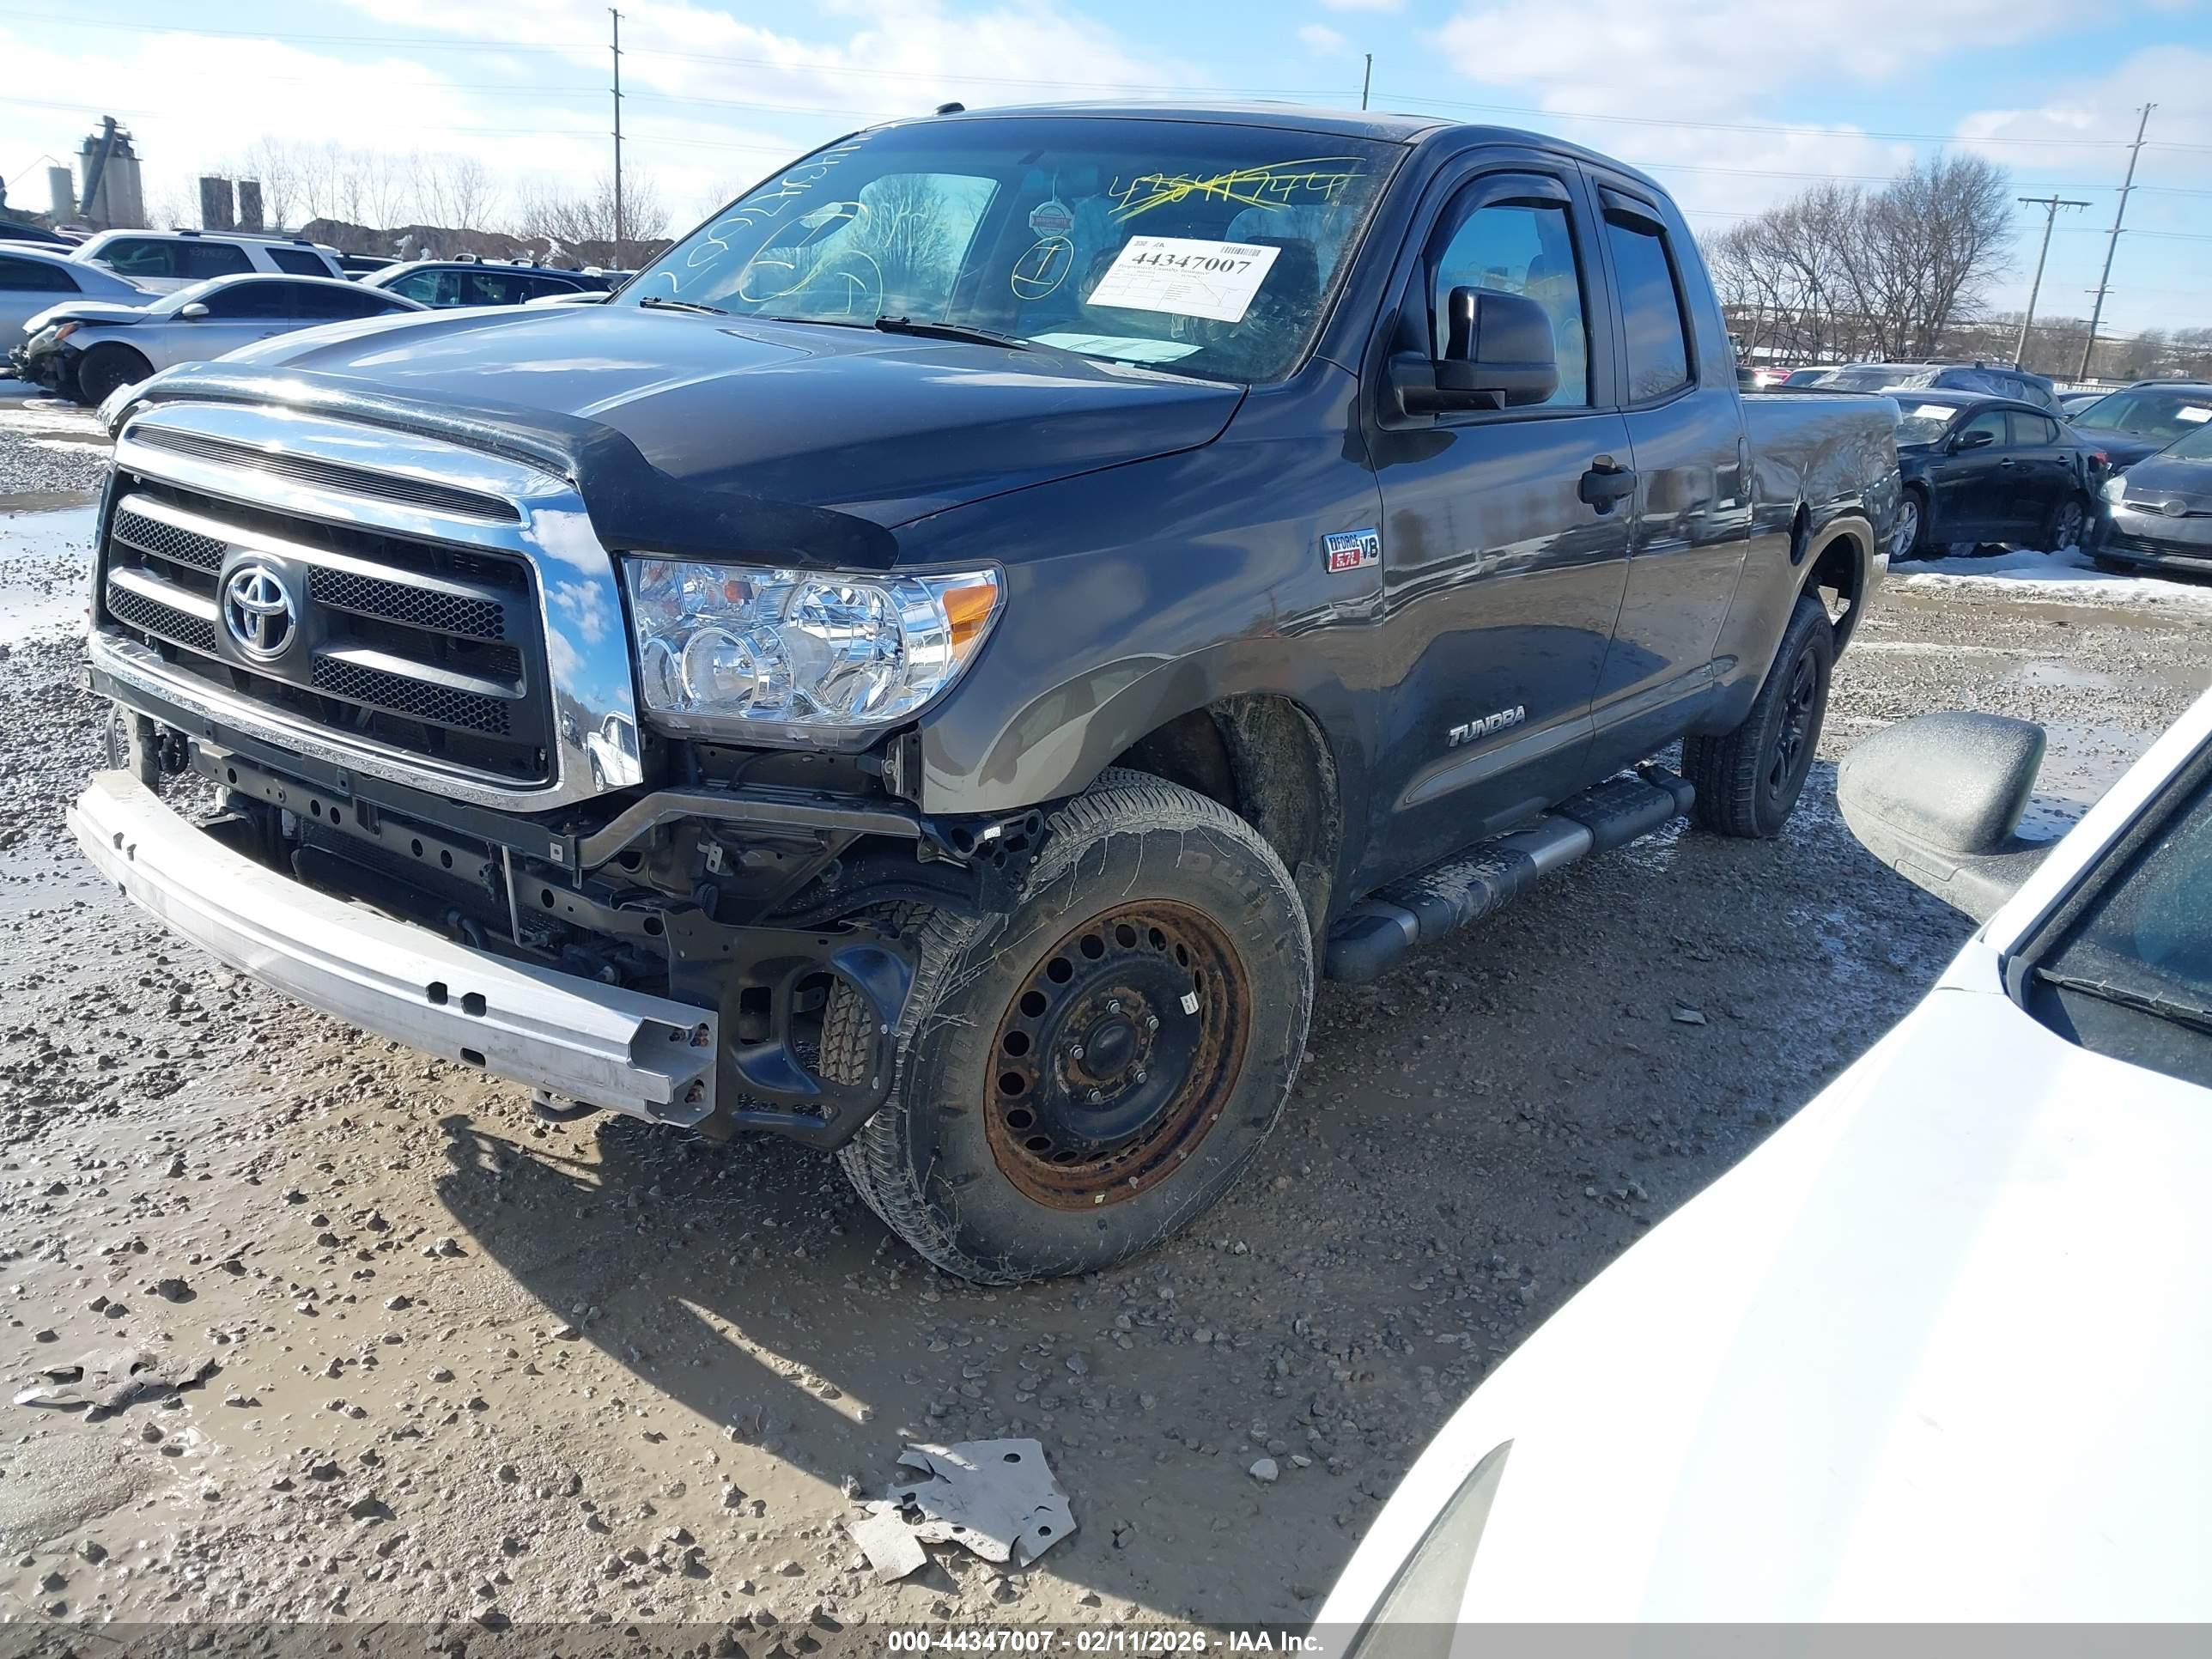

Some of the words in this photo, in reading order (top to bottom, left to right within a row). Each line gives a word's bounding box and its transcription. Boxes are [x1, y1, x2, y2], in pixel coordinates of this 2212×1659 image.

[1132, 252, 1252, 275] 44347007
[1359, 537, 1378, 559] V8
[1449, 705, 1526, 747] TUNDRA
